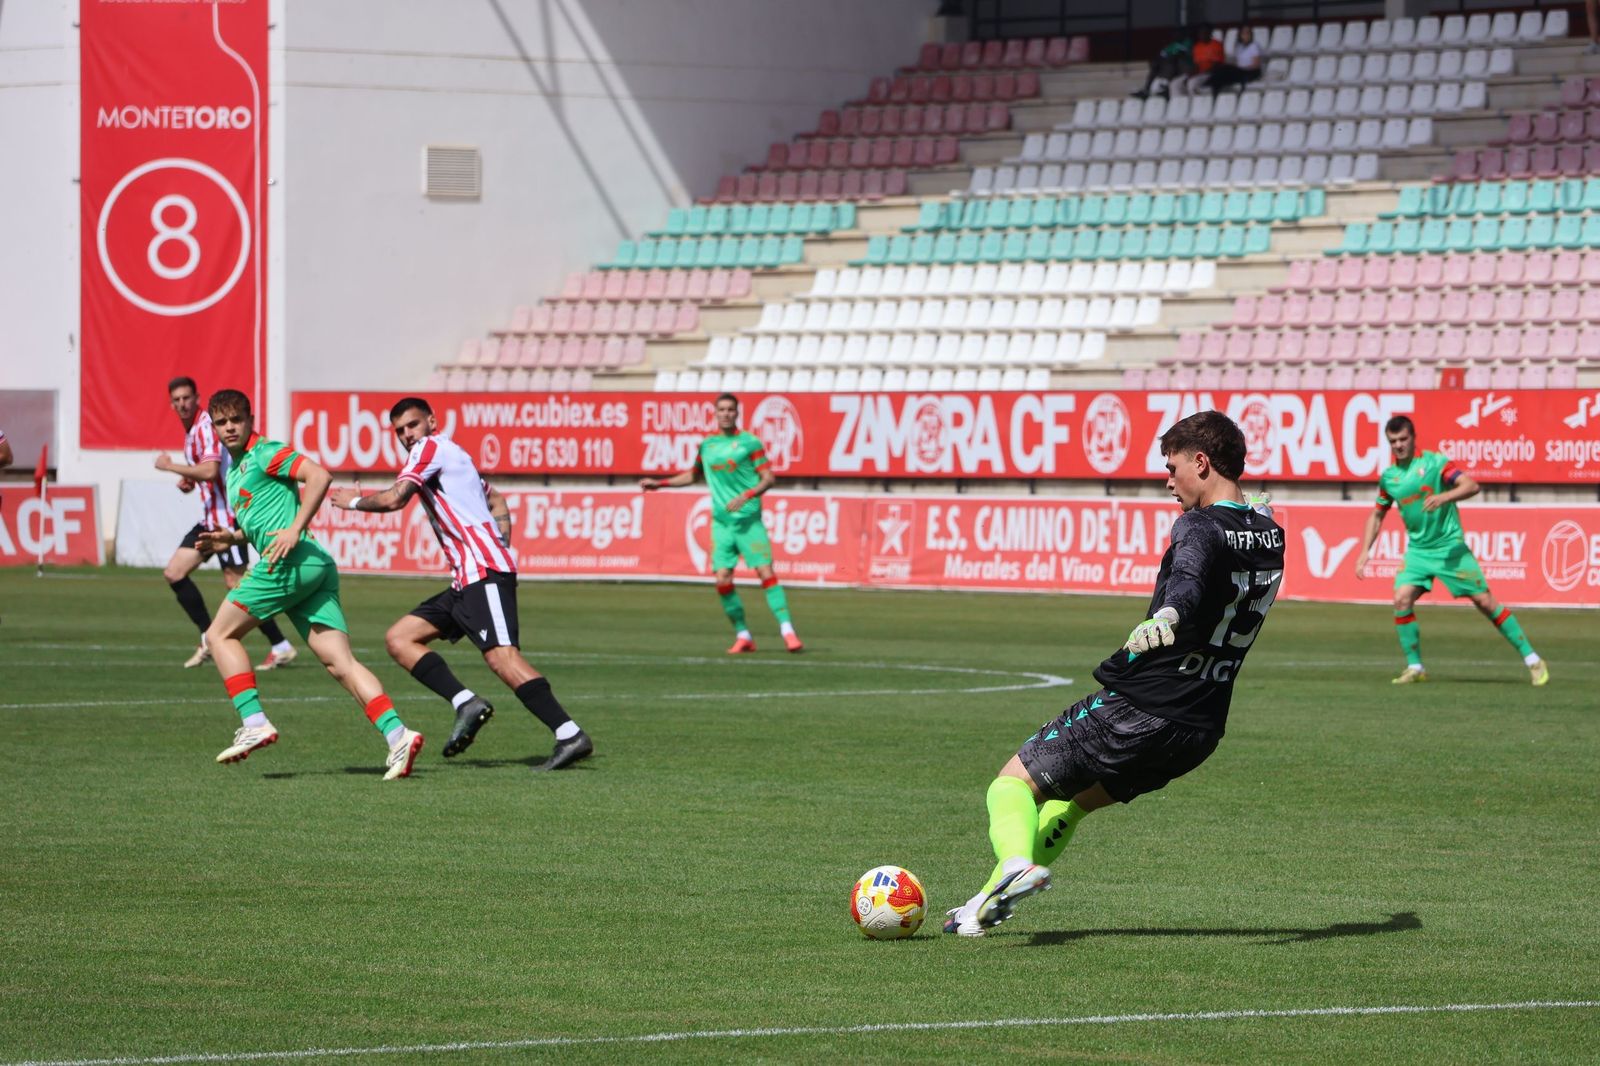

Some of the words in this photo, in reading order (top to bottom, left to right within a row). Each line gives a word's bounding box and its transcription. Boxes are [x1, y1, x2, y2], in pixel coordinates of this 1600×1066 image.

[97, 105, 251, 129] MONTETORO
[147, 194, 200, 279] 8
[461, 395, 629, 428] www.cubiex.es
[642, 401, 744, 432] FUNDAC
[829, 393, 1006, 473] ZAMORA
[1010, 393, 1077, 473] CF
[509, 438, 543, 468] 675
[546, 438, 579, 468] 630
[583, 438, 614, 468] 110
[1145, 392, 1340, 476] ZORA
[1438, 434, 1536, 469] sangregorio
[524, 495, 645, 550] Freigel
[761, 499, 839, 555] eigel
[926, 505, 968, 551] E.S.
[974, 505, 1074, 553] CAMINO
[1080, 508, 1111, 553] DE
[1117, 509, 1149, 556] LA
[944, 553, 1020, 581] Morales
[1024, 555, 1056, 582] del
[1060, 556, 1104, 584] Vino
